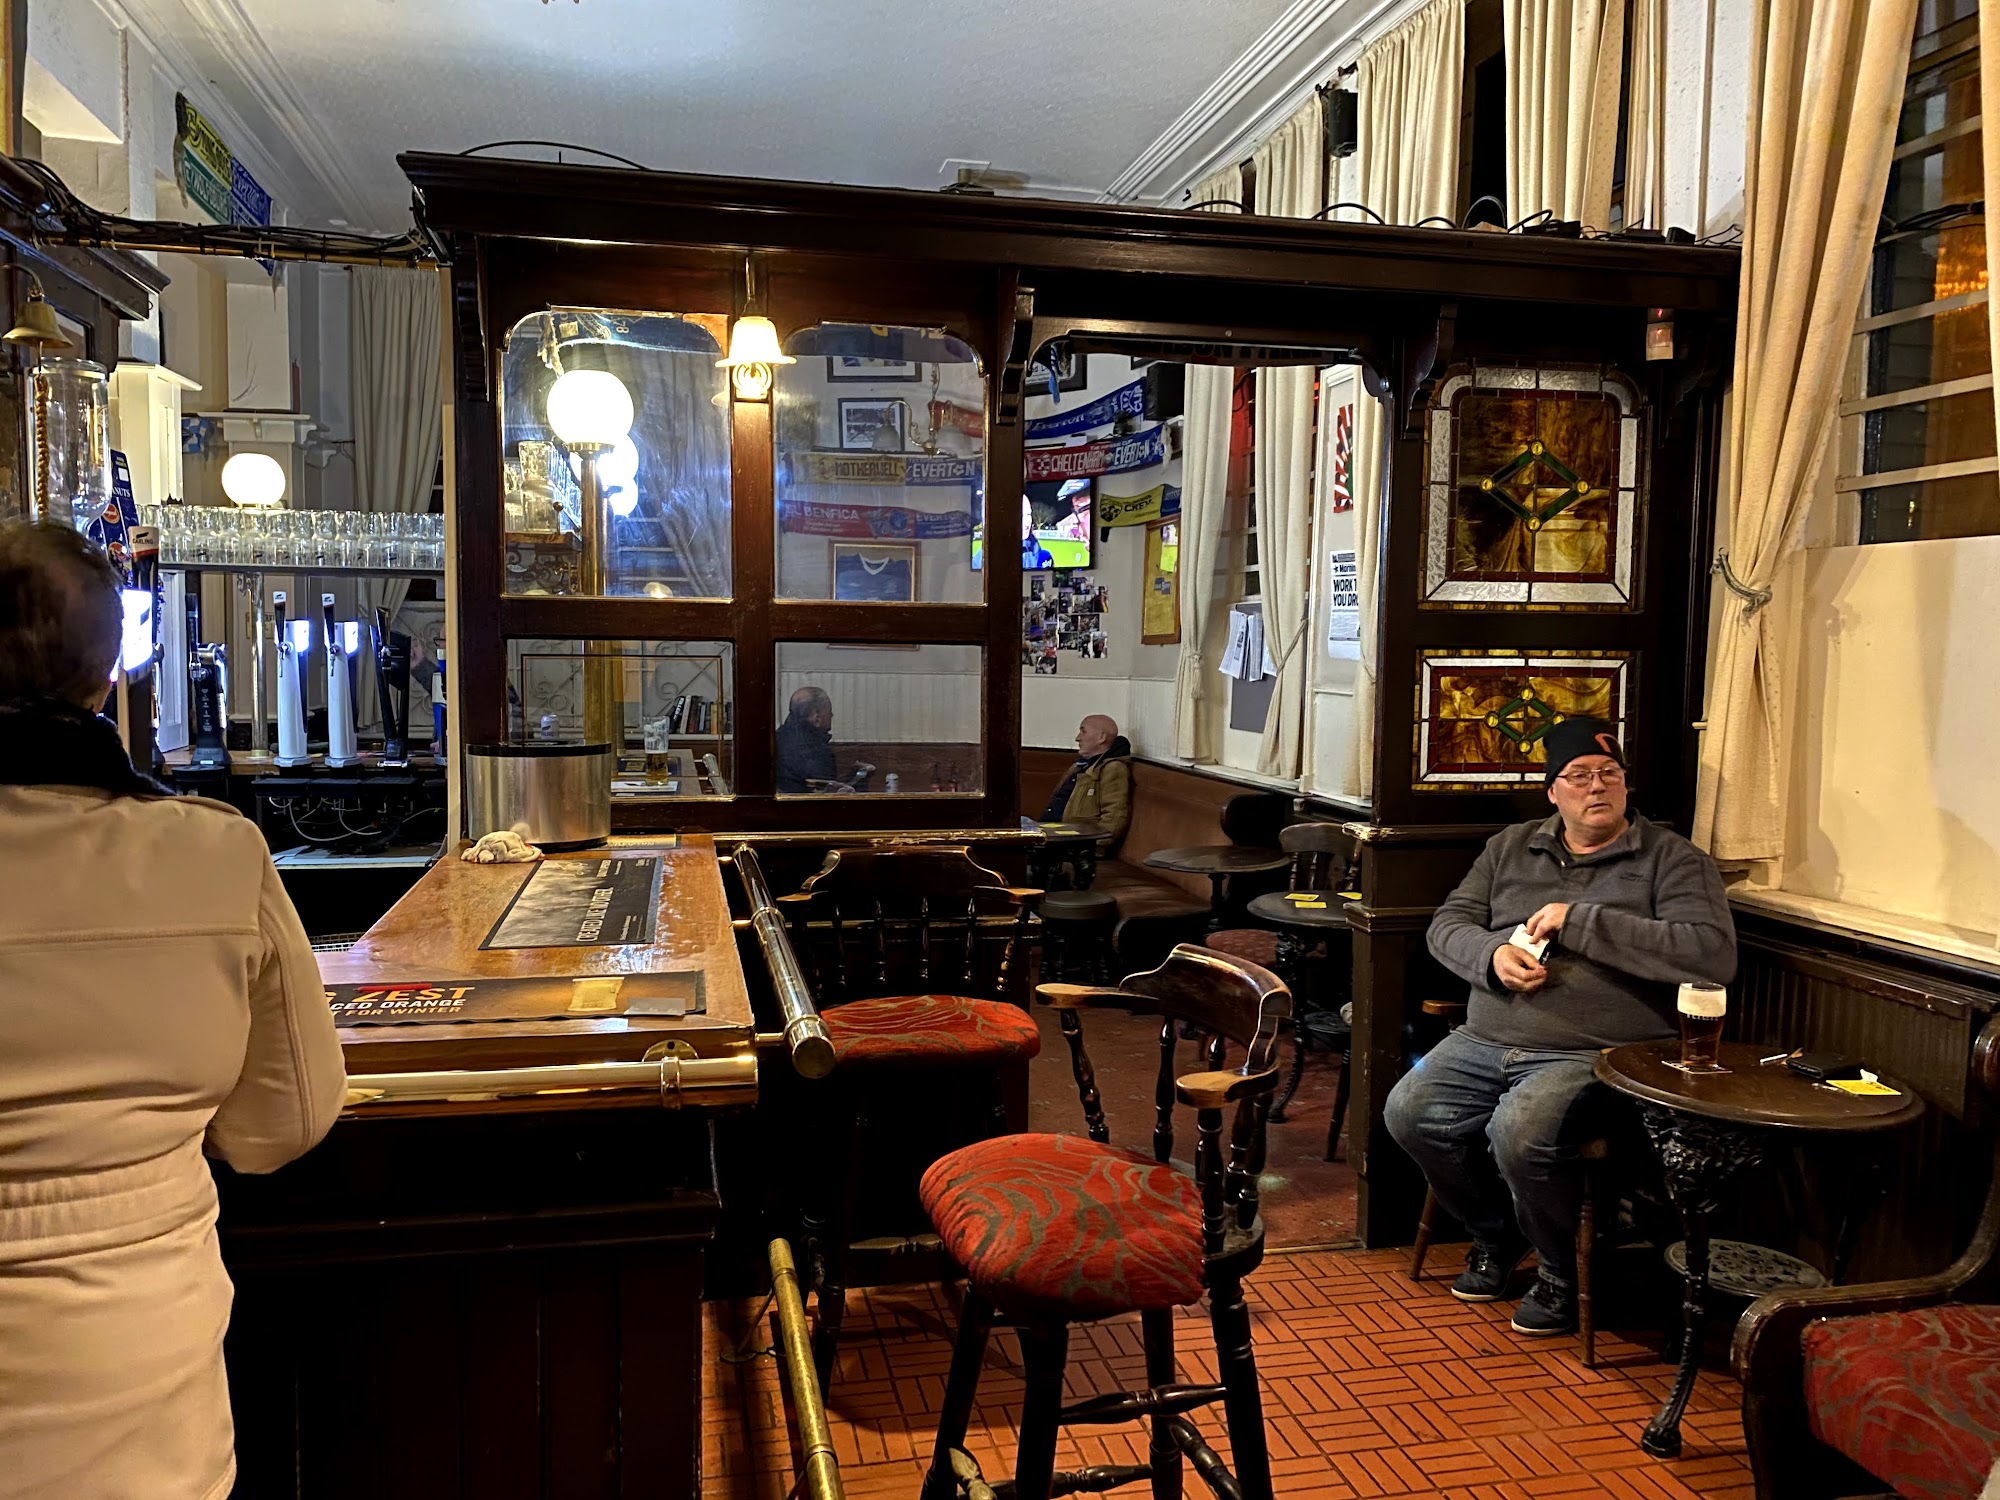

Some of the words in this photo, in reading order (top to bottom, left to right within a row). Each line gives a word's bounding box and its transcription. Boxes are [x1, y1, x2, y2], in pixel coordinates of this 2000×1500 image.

[1134, 384, 1143, 412] CUP
[1113, 440, 1150, 466] EVERTON
[1051, 450, 1106, 473] CHELTENHAM
[835, 462, 899, 477] MOTHERWELL
[803, 506, 860, 521] BENFICA
[1333, 578, 1353, 593] WORK
[1333, 593, 1347, 607] YOU
[576, 920, 603, 942] CREATED
[352, 986, 476, 1003] ZEST
[380, 999, 466, 1009] ORANGE
[390, 1006, 461, 1015] WINTER
